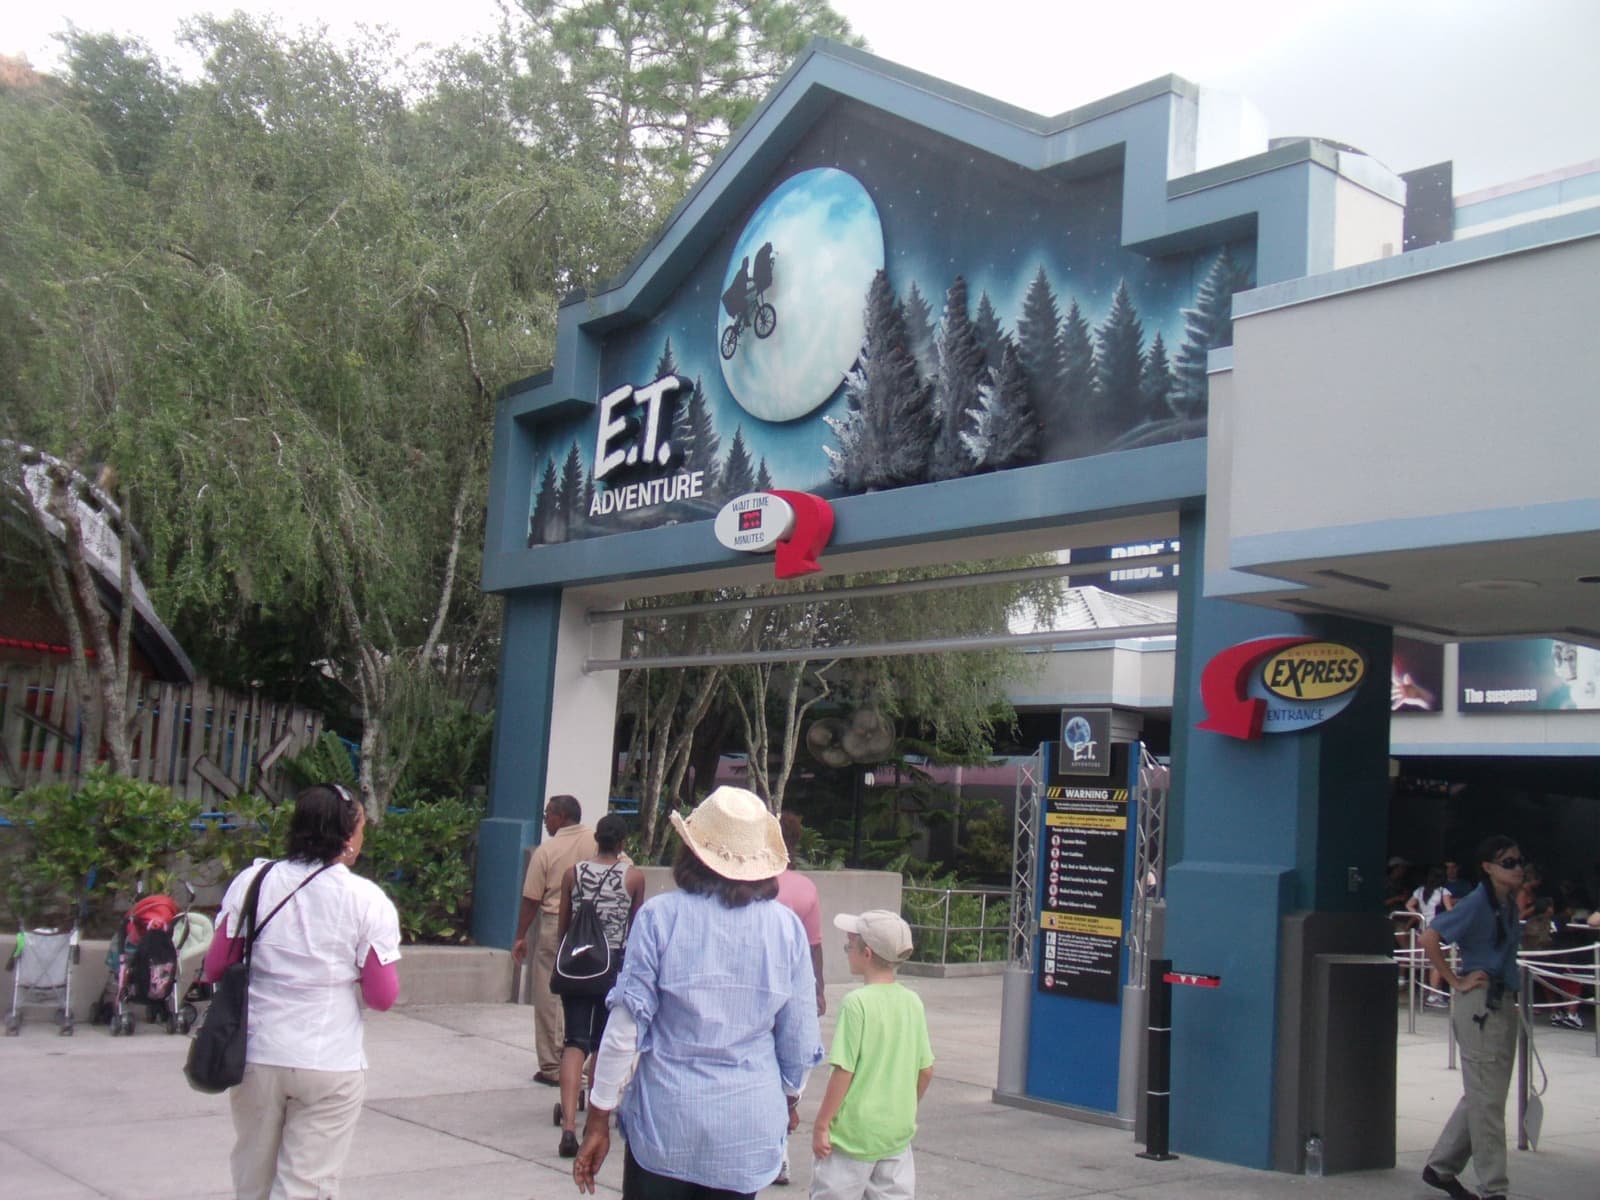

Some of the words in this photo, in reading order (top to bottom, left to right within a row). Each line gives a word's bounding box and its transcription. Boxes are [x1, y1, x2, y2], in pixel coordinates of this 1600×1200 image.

[593, 374, 680, 480] E.T.
[589, 471, 705, 517] ADVENTURE
[732, 499, 750, 512] WAIT
[752, 496, 769, 509] TIME
[734, 532, 765, 545] MINUTES
[1270, 658, 1360, 697] EXPRESS
[1464, 688, 1484, 703] The
[1267, 708, 1324, 721] ENTRANCE
[1073, 741, 1097, 761] E.T.
[1065, 789, 1108, 800] WARNING
